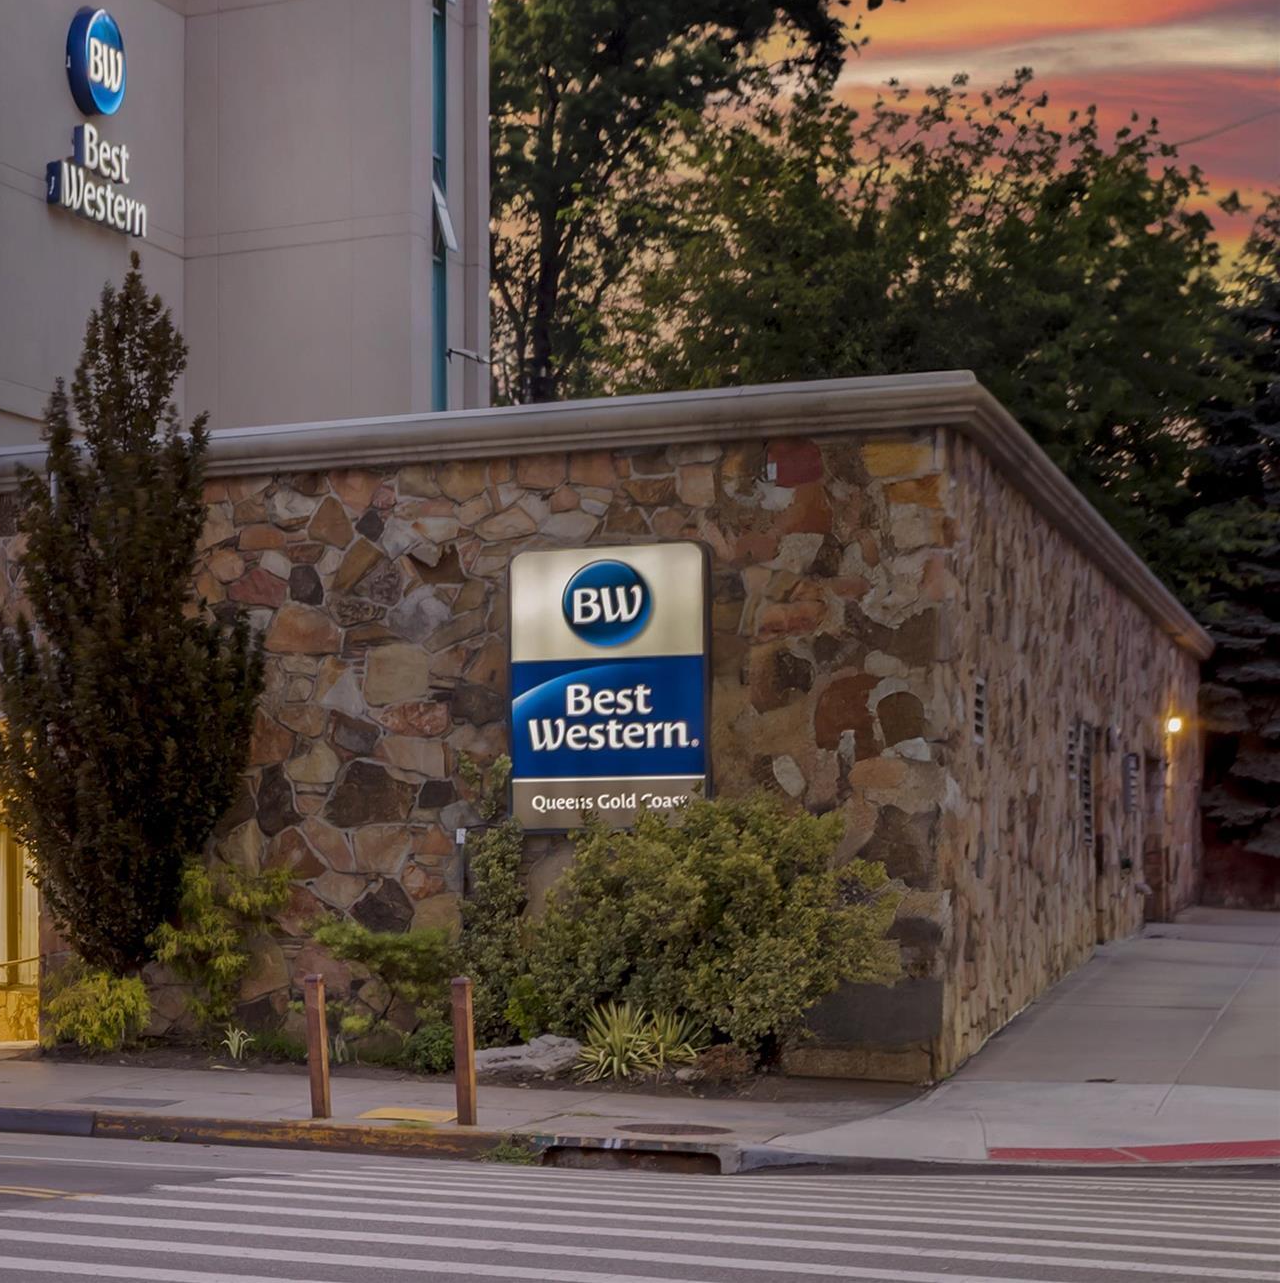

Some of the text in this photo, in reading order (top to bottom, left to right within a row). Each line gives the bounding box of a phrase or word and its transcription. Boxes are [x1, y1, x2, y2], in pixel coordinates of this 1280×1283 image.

[90, 36, 123, 94] BW
[82, 122, 130, 184] Best
[60, 161, 147, 238] Western
[572, 584, 643, 625] BW
[566, 683, 653, 717] Best
[528, 718, 690, 752] Western
[531, 794, 594, 813] Queens
[597, 792, 636, 809] Gold
